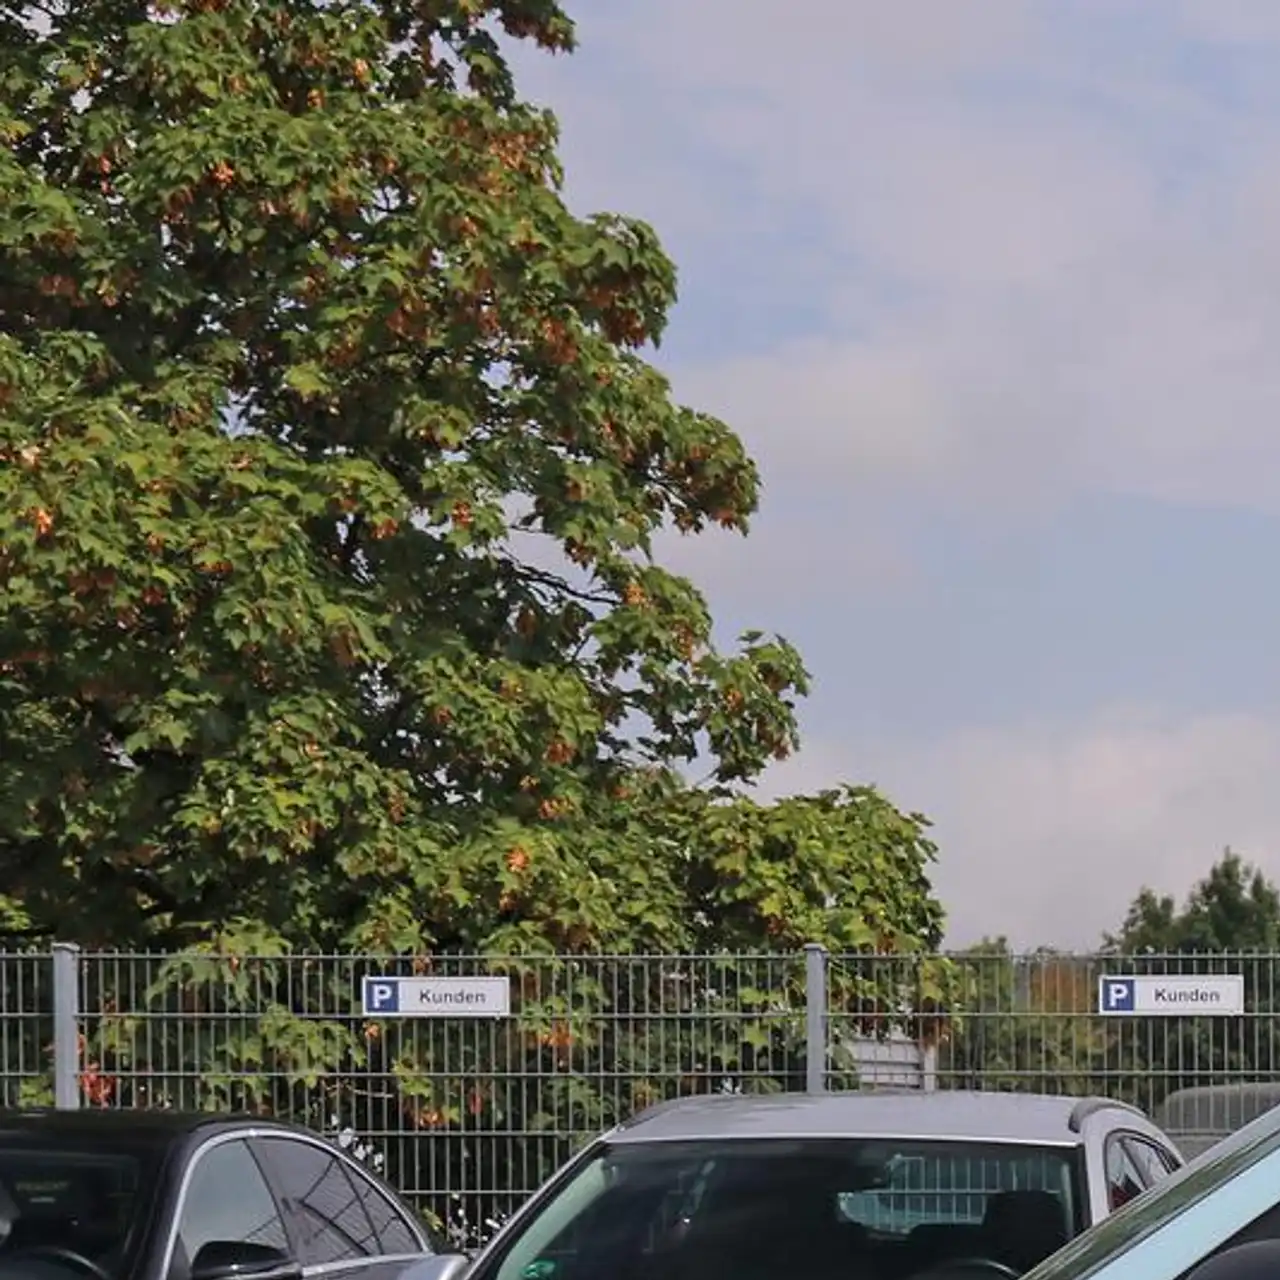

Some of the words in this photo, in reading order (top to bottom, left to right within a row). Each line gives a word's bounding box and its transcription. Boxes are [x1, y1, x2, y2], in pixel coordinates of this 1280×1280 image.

[371, 983, 392, 1009] P
[418, 988, 487, 1005] Kunden
[1108, 982, 1129, 1008] P
[1153, 987, 1221, 1003] Kunden
